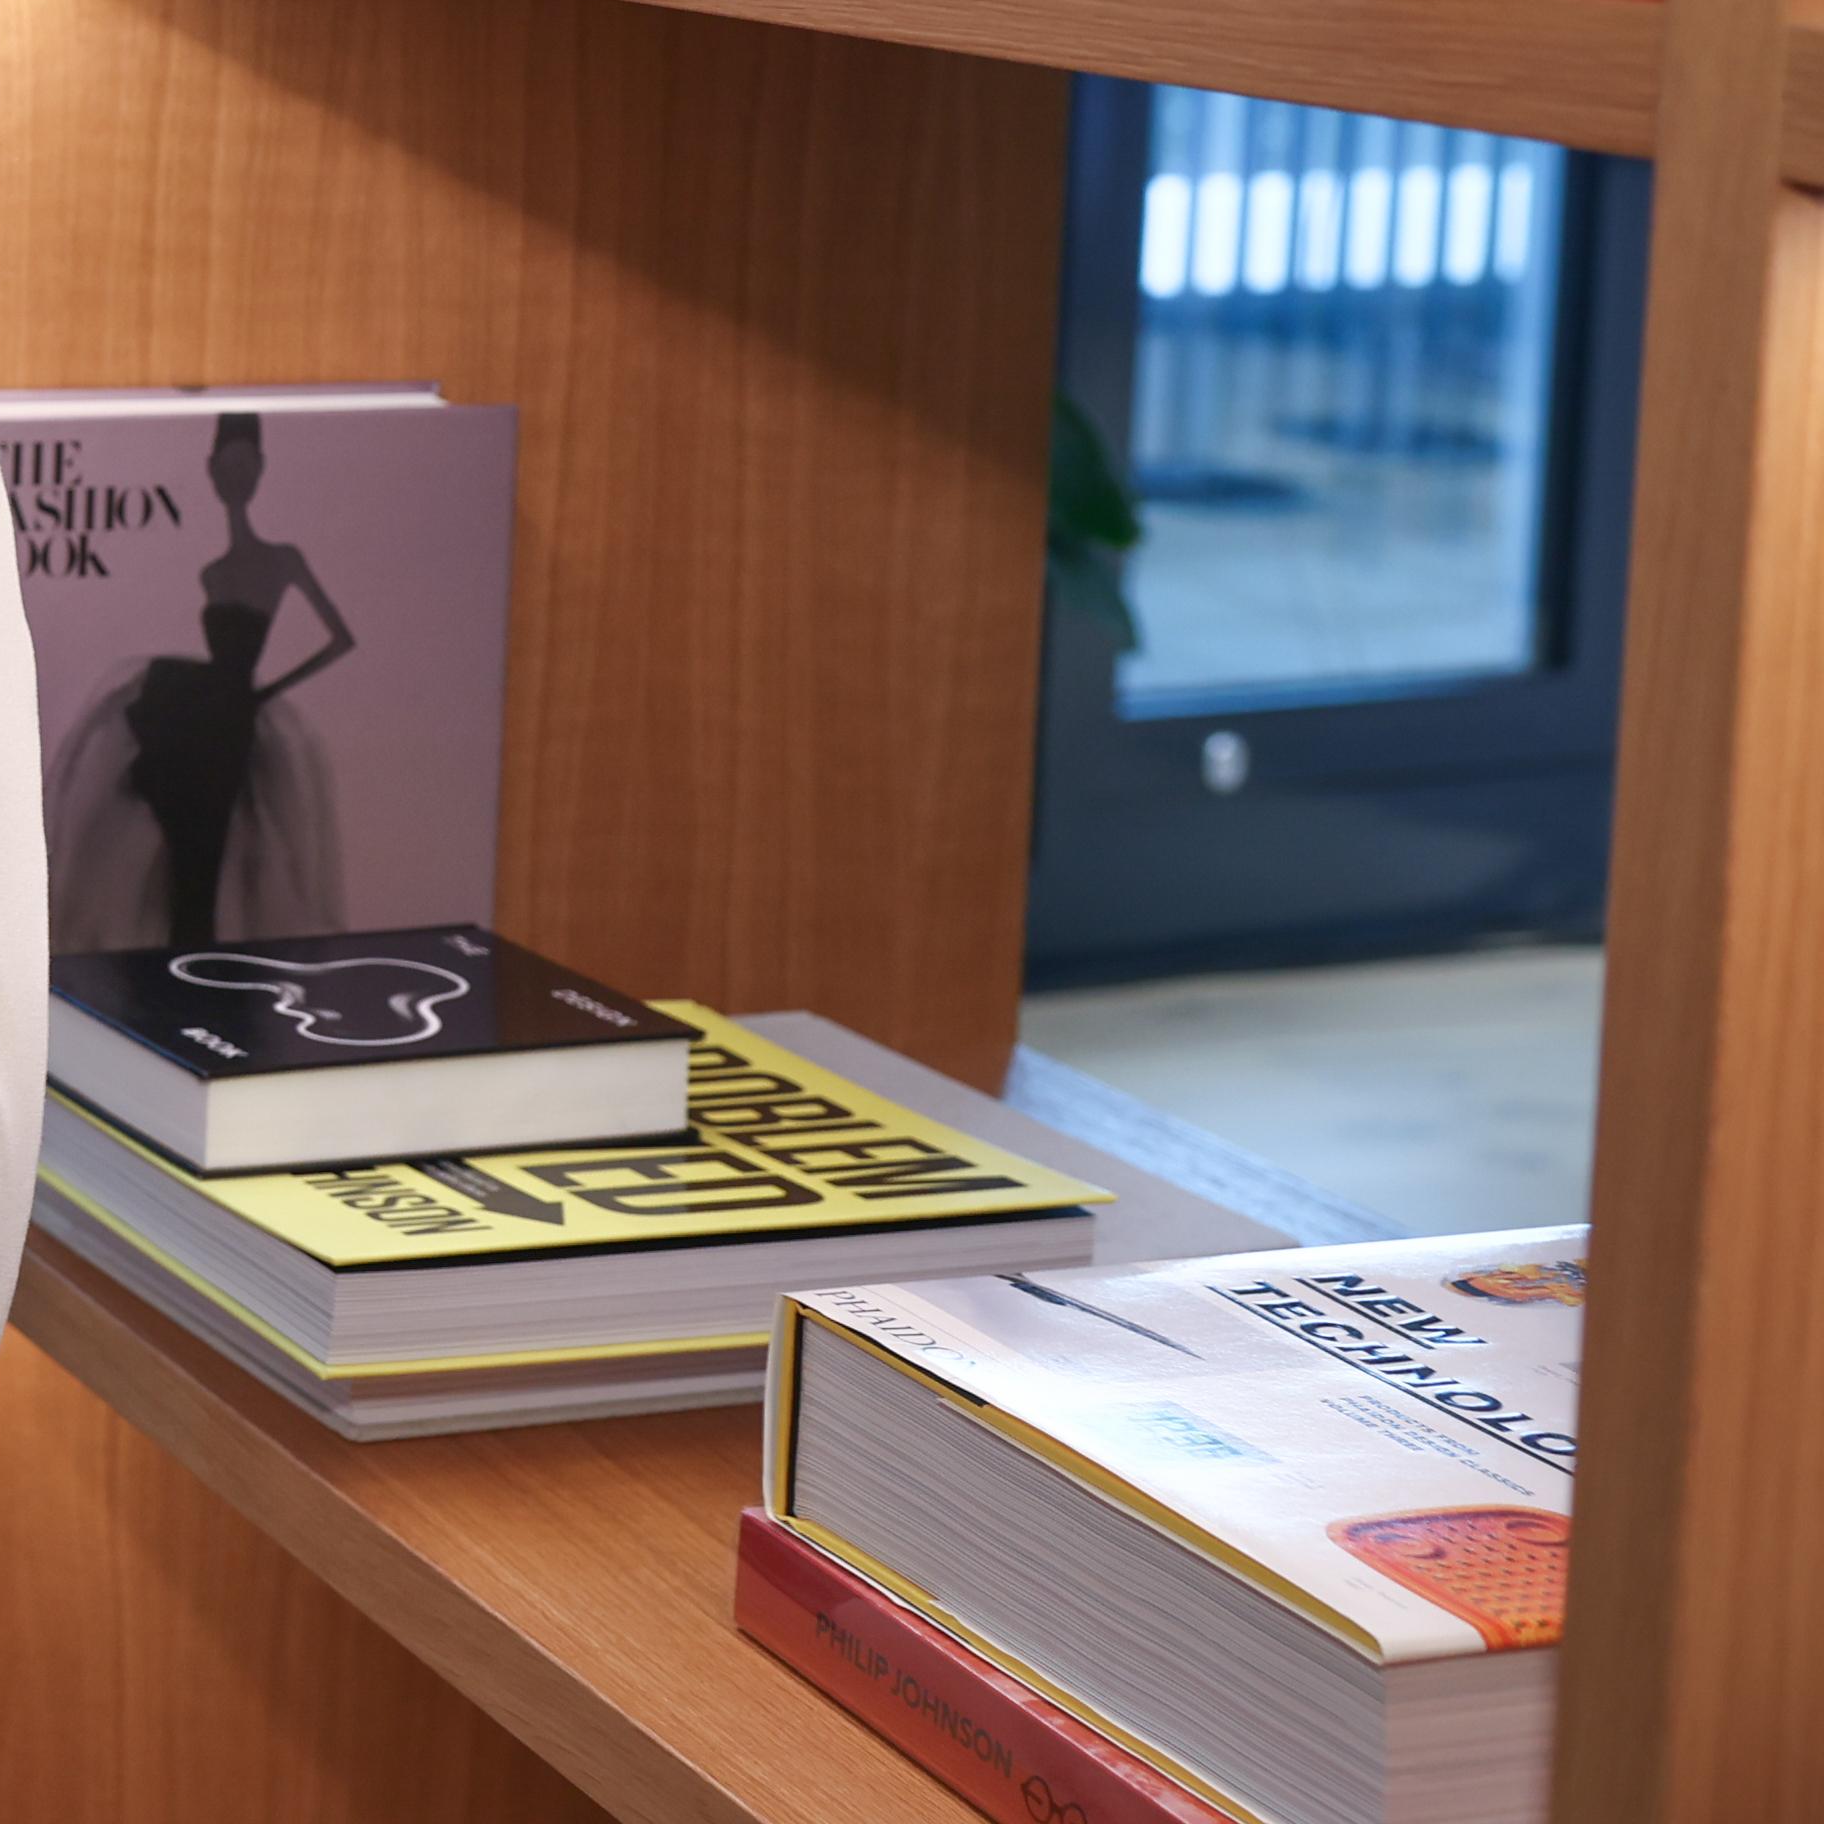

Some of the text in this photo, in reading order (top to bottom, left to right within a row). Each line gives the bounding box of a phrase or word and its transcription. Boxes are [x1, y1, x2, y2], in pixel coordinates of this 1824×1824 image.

[10, 483, 182, 533] ASHION
[688, 1044, 1030, 1201] OBLEM
[814, 1290, 976, 1368] PHAIDO
[1311, 1272, 1488, 1345] NEW
[1228, 1280, 1578, 1457] TECHNOLO
[815, 1611, 1014, 1778] PHILIP JOHNSON
